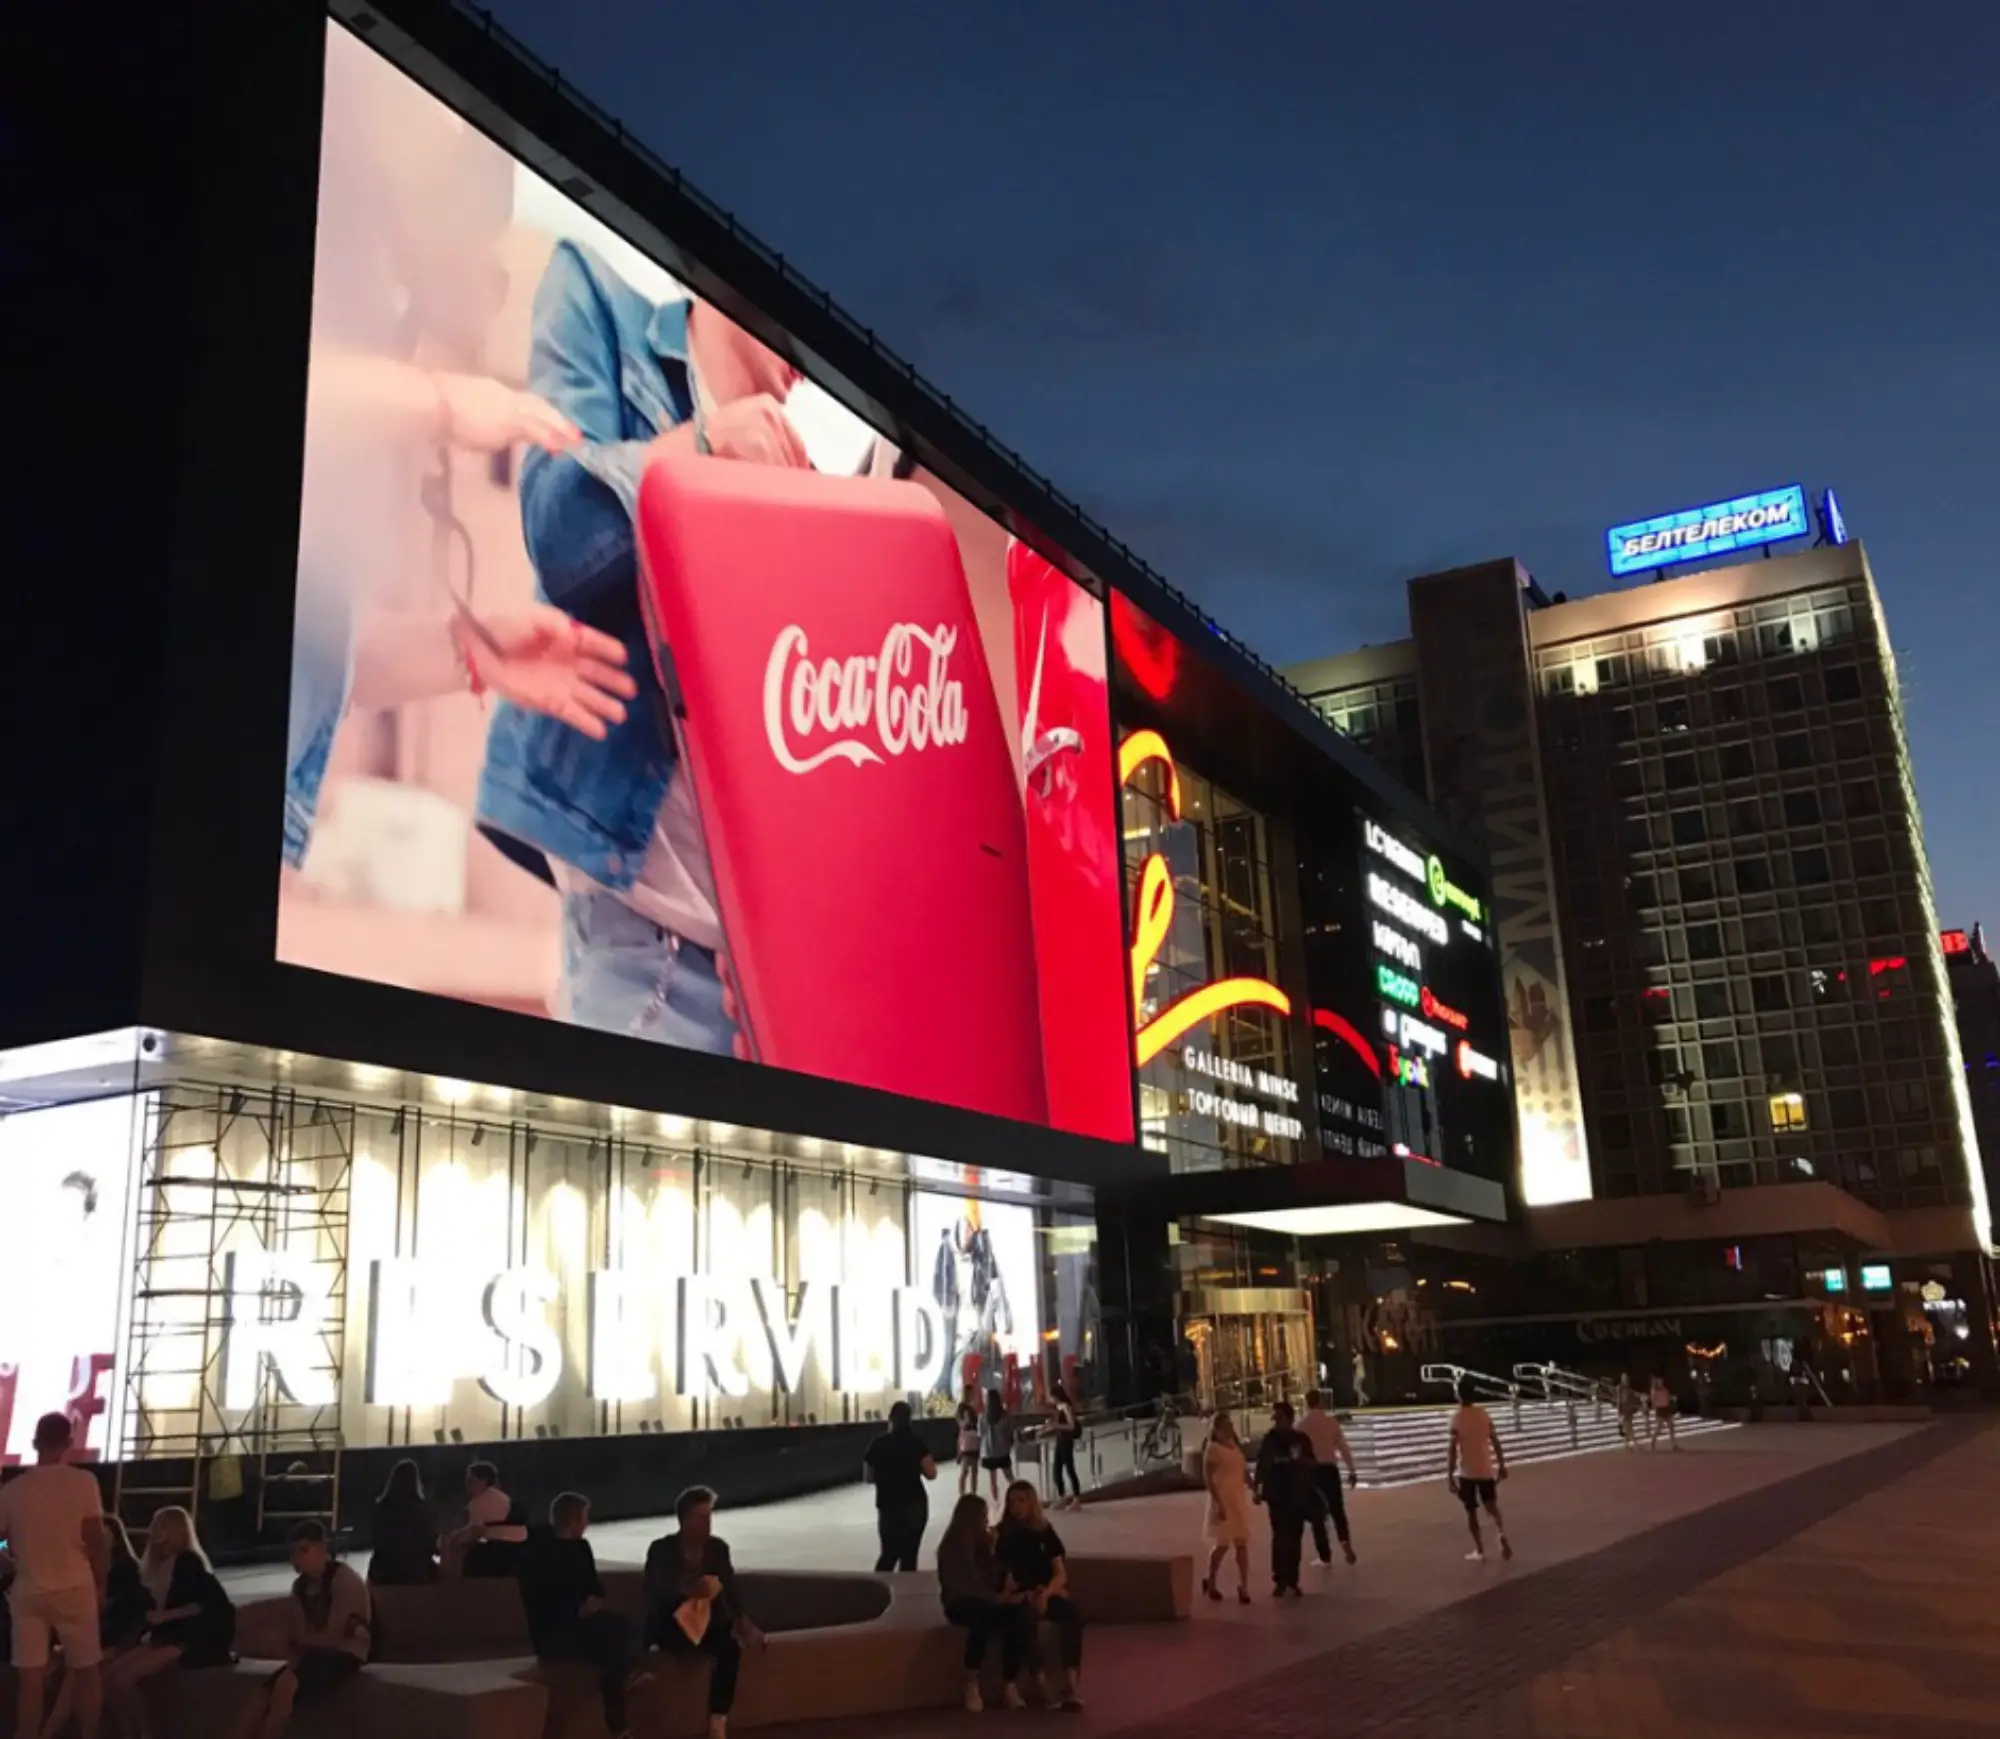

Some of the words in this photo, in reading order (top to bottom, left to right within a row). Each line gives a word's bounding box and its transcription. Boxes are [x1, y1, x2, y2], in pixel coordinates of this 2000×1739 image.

[1623, 503, 1790, 557] БЕЛТЕЛЕКОМ
[1184, 1045, 1254, 1089] GALLERIA
[1258, 1069, 1299, 1103] MINSK
